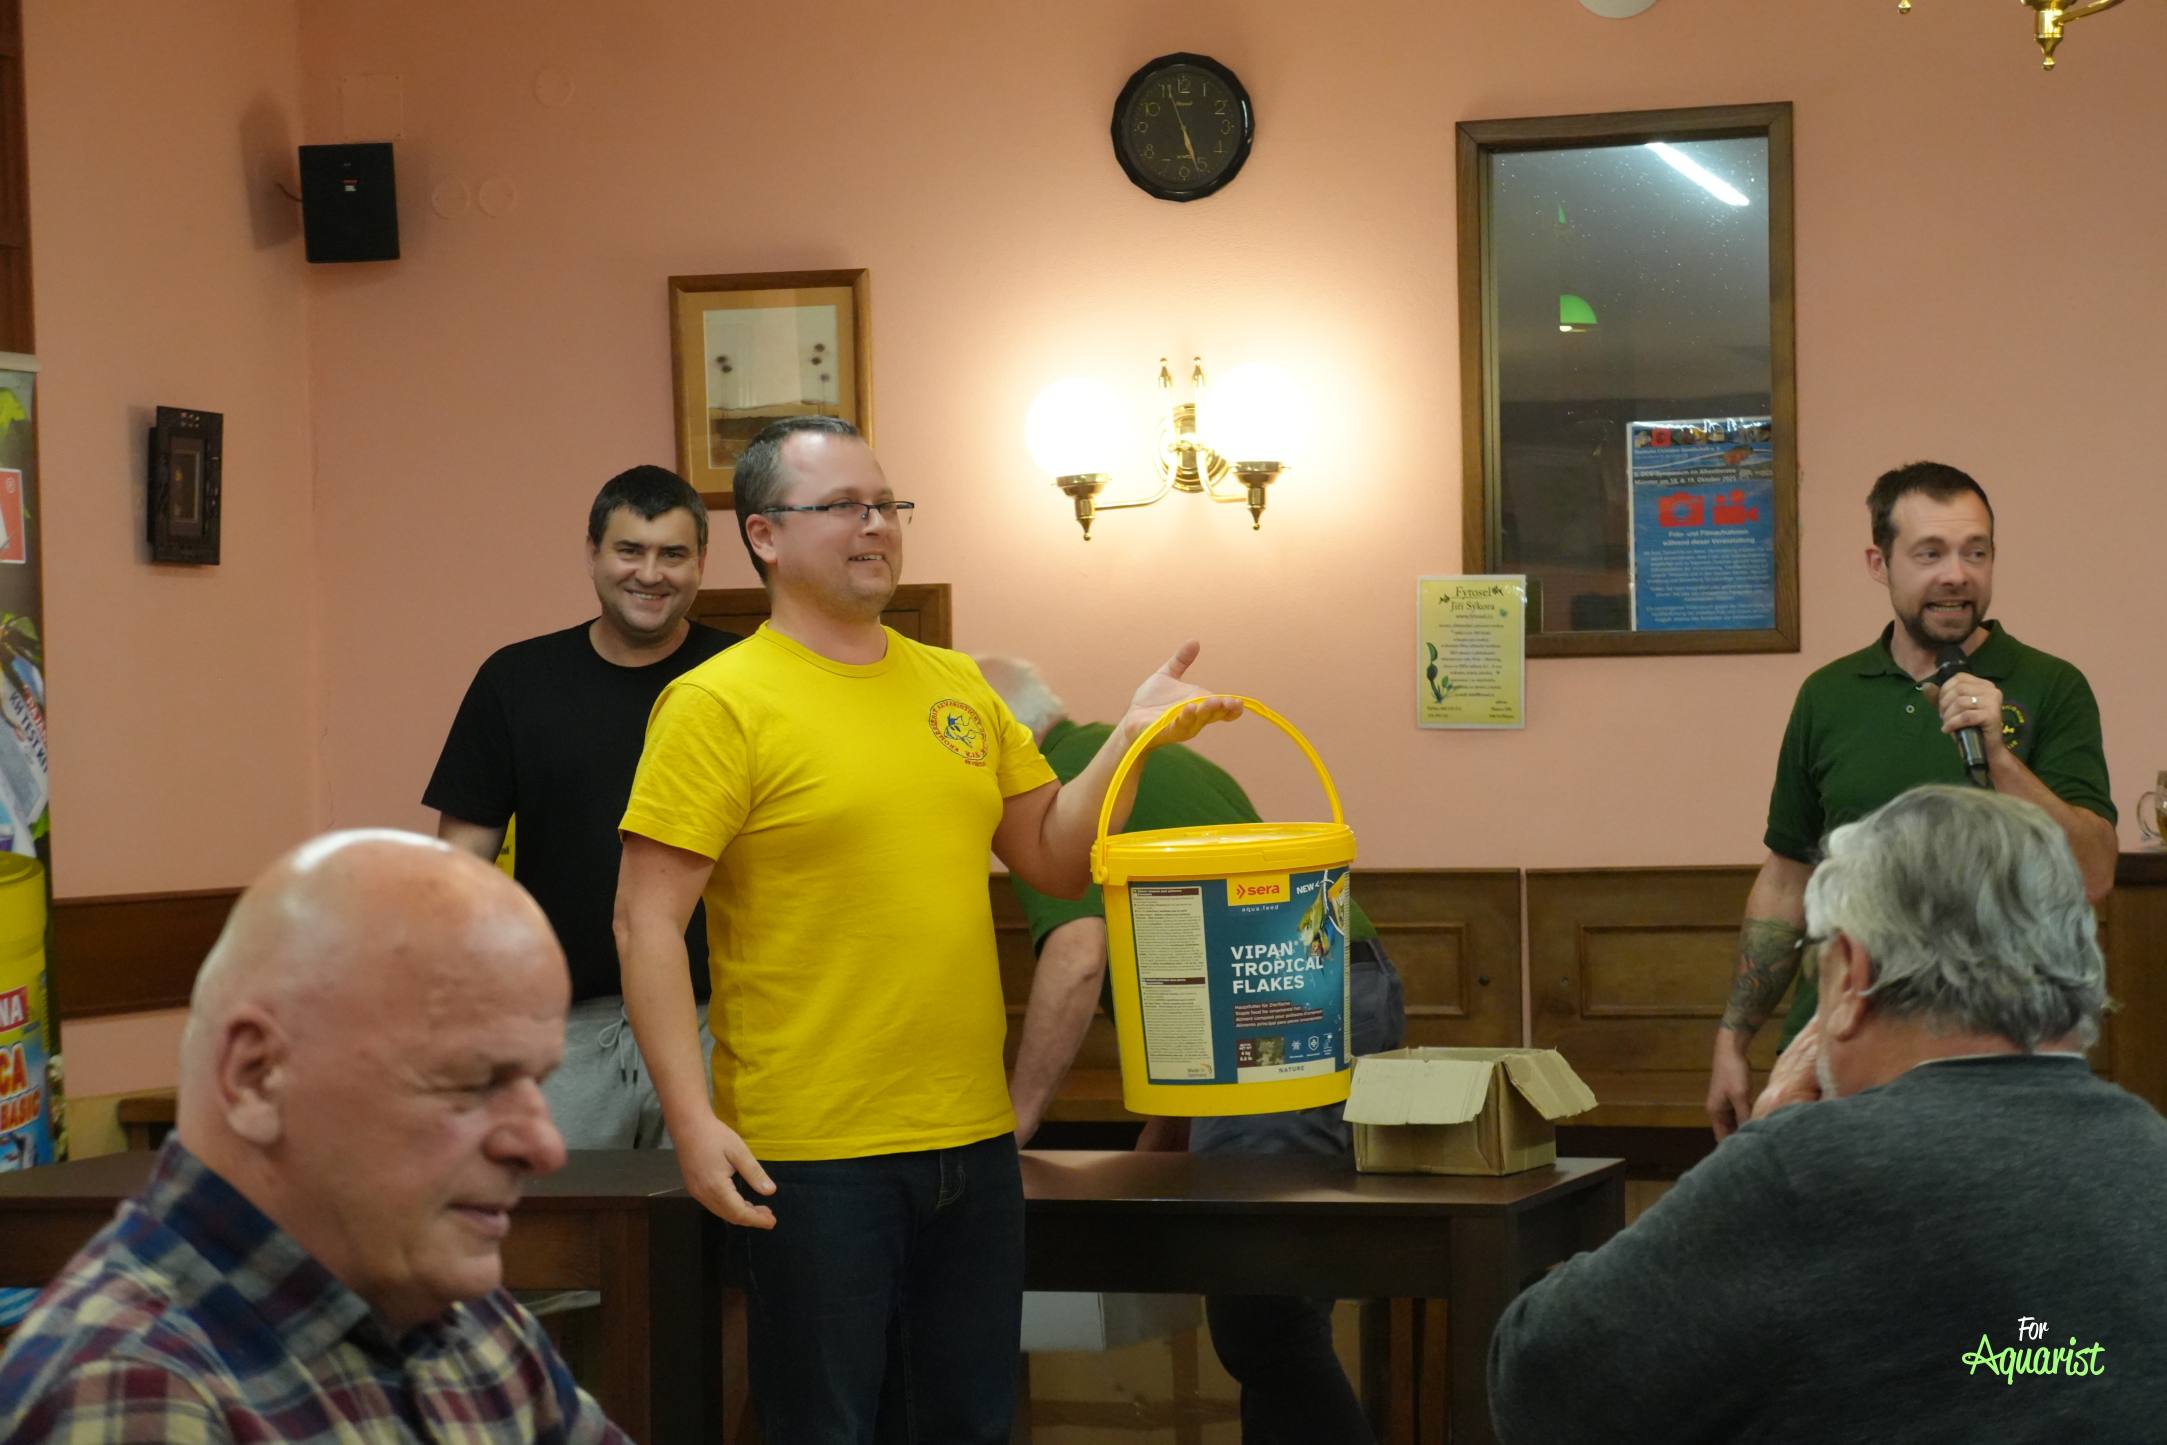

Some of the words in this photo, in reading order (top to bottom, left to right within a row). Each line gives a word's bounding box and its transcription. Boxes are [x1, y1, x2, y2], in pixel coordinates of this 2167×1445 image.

[22, 715, 40, 748] TEST
[1247, 884, 1280, 896] sera
[1296, 883, 1315, 895] NEW
[1231, 956, 1324, 977] TROPICAL
[1232, 975, 1305, 995] FLAKES
[1278, 1065, 1305, 1073] NATURE
